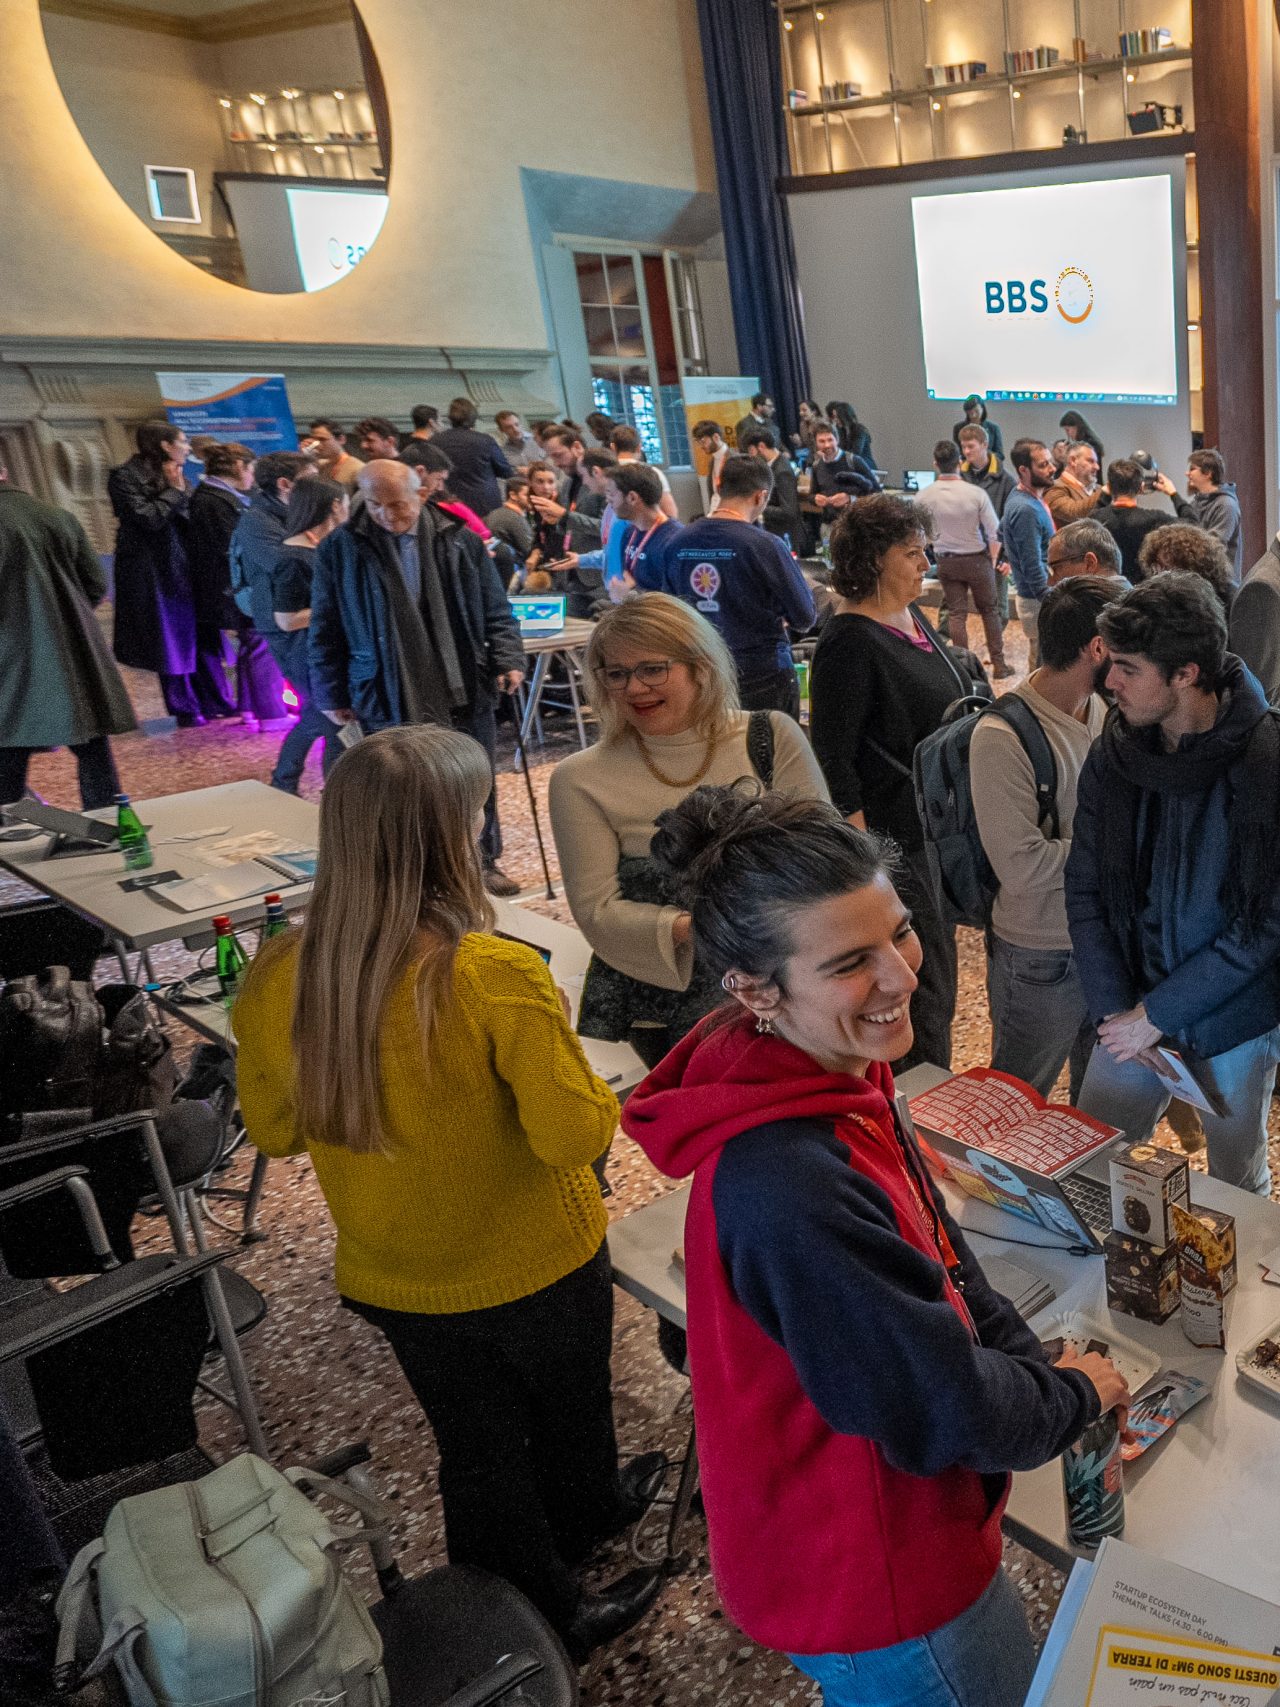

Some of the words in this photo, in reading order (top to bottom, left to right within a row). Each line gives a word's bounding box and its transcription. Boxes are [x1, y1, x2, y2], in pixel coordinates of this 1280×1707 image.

[984, 279, 1048, 314] BBS
[1111, 1590, 1149, 1614] THEMATIK
[1148, 1605, 1173, 1624] TALKS
[1114, 1580, 1148, 1600] STARTUP
[1147, 1593, 1192, 1622] ECOSYSTEM
[1191, 1612, 1208, 1627] DAY
[1112, 1650, 1151, 1667] TERRA
[1151, 1655, 1170, 1669] DI
[1197, 1663, 1232, 1679] SONO
[1233, 1667, 1278, 1685] QUESTI
